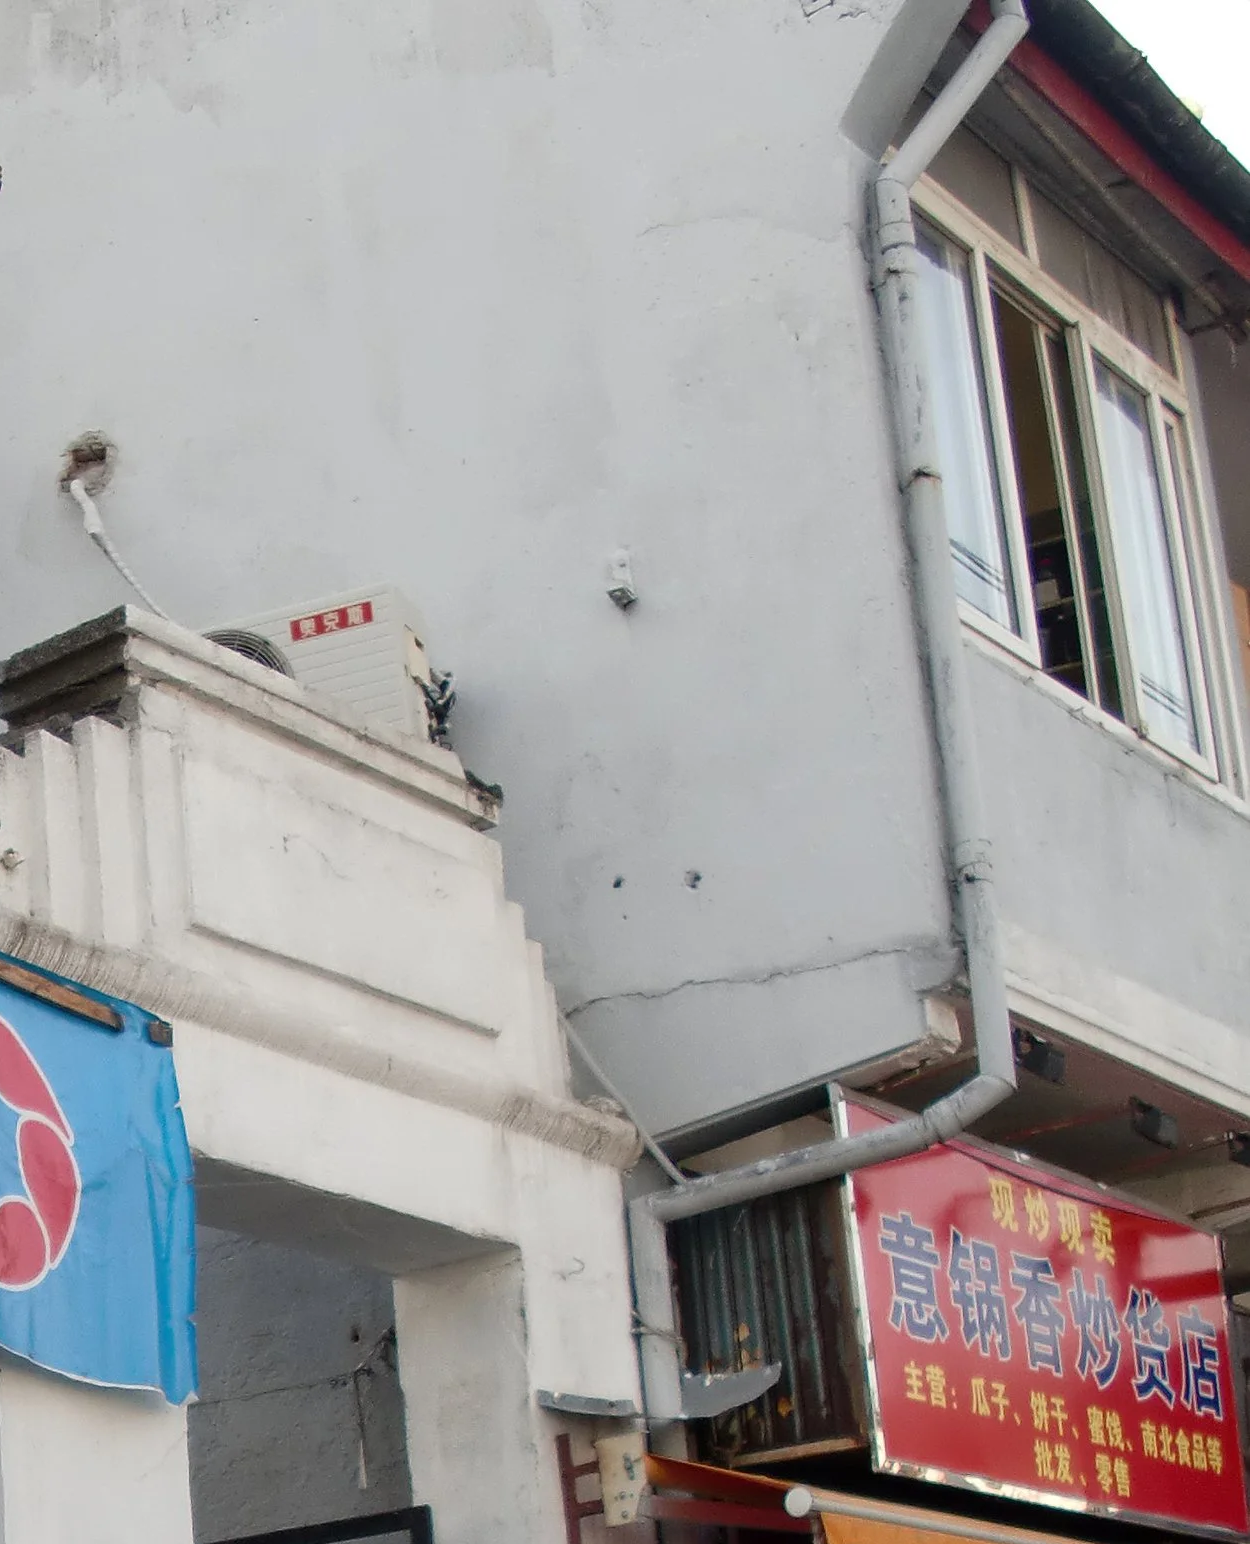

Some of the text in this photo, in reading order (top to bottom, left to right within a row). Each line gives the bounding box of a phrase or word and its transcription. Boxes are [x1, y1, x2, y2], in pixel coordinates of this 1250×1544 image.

[989, 1177, 1115, 1265] 现炒现卖
[879, 1213, 1223, 1421] 意锅香炒货店
